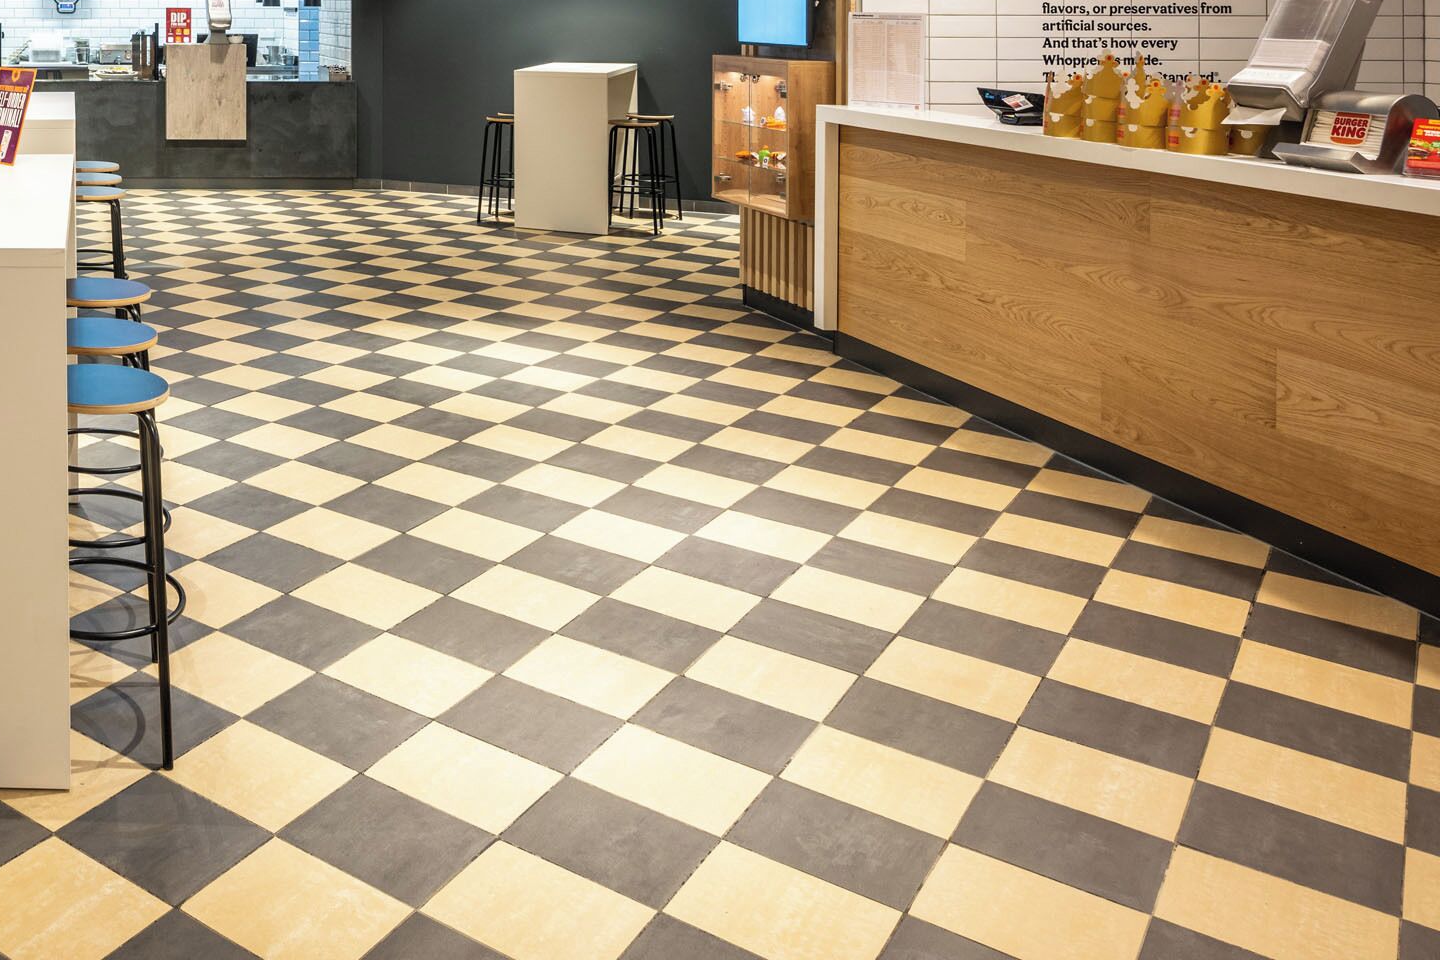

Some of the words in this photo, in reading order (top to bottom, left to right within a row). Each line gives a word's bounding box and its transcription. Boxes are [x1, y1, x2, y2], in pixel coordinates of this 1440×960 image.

[1042, 3, 1090, 17] flavors,
[1092, 5, 1107, 15] or
[1109, 3, 1198, 17] preservatives
[1200, 3, 1232, 15] from
[1042, 20, 1095, 31] artificial
[1097, 23, 1152, 31] sources.
[1042, 37, 1069, 49] And
[1110, 37, 1139, 49] how
[1141, 40, 1178, 51] every
[1123, 55, 1163, 66] mde.
[1334, 117, 1368, 128] BURGER
[1331, 125, 1366, 138] KING
